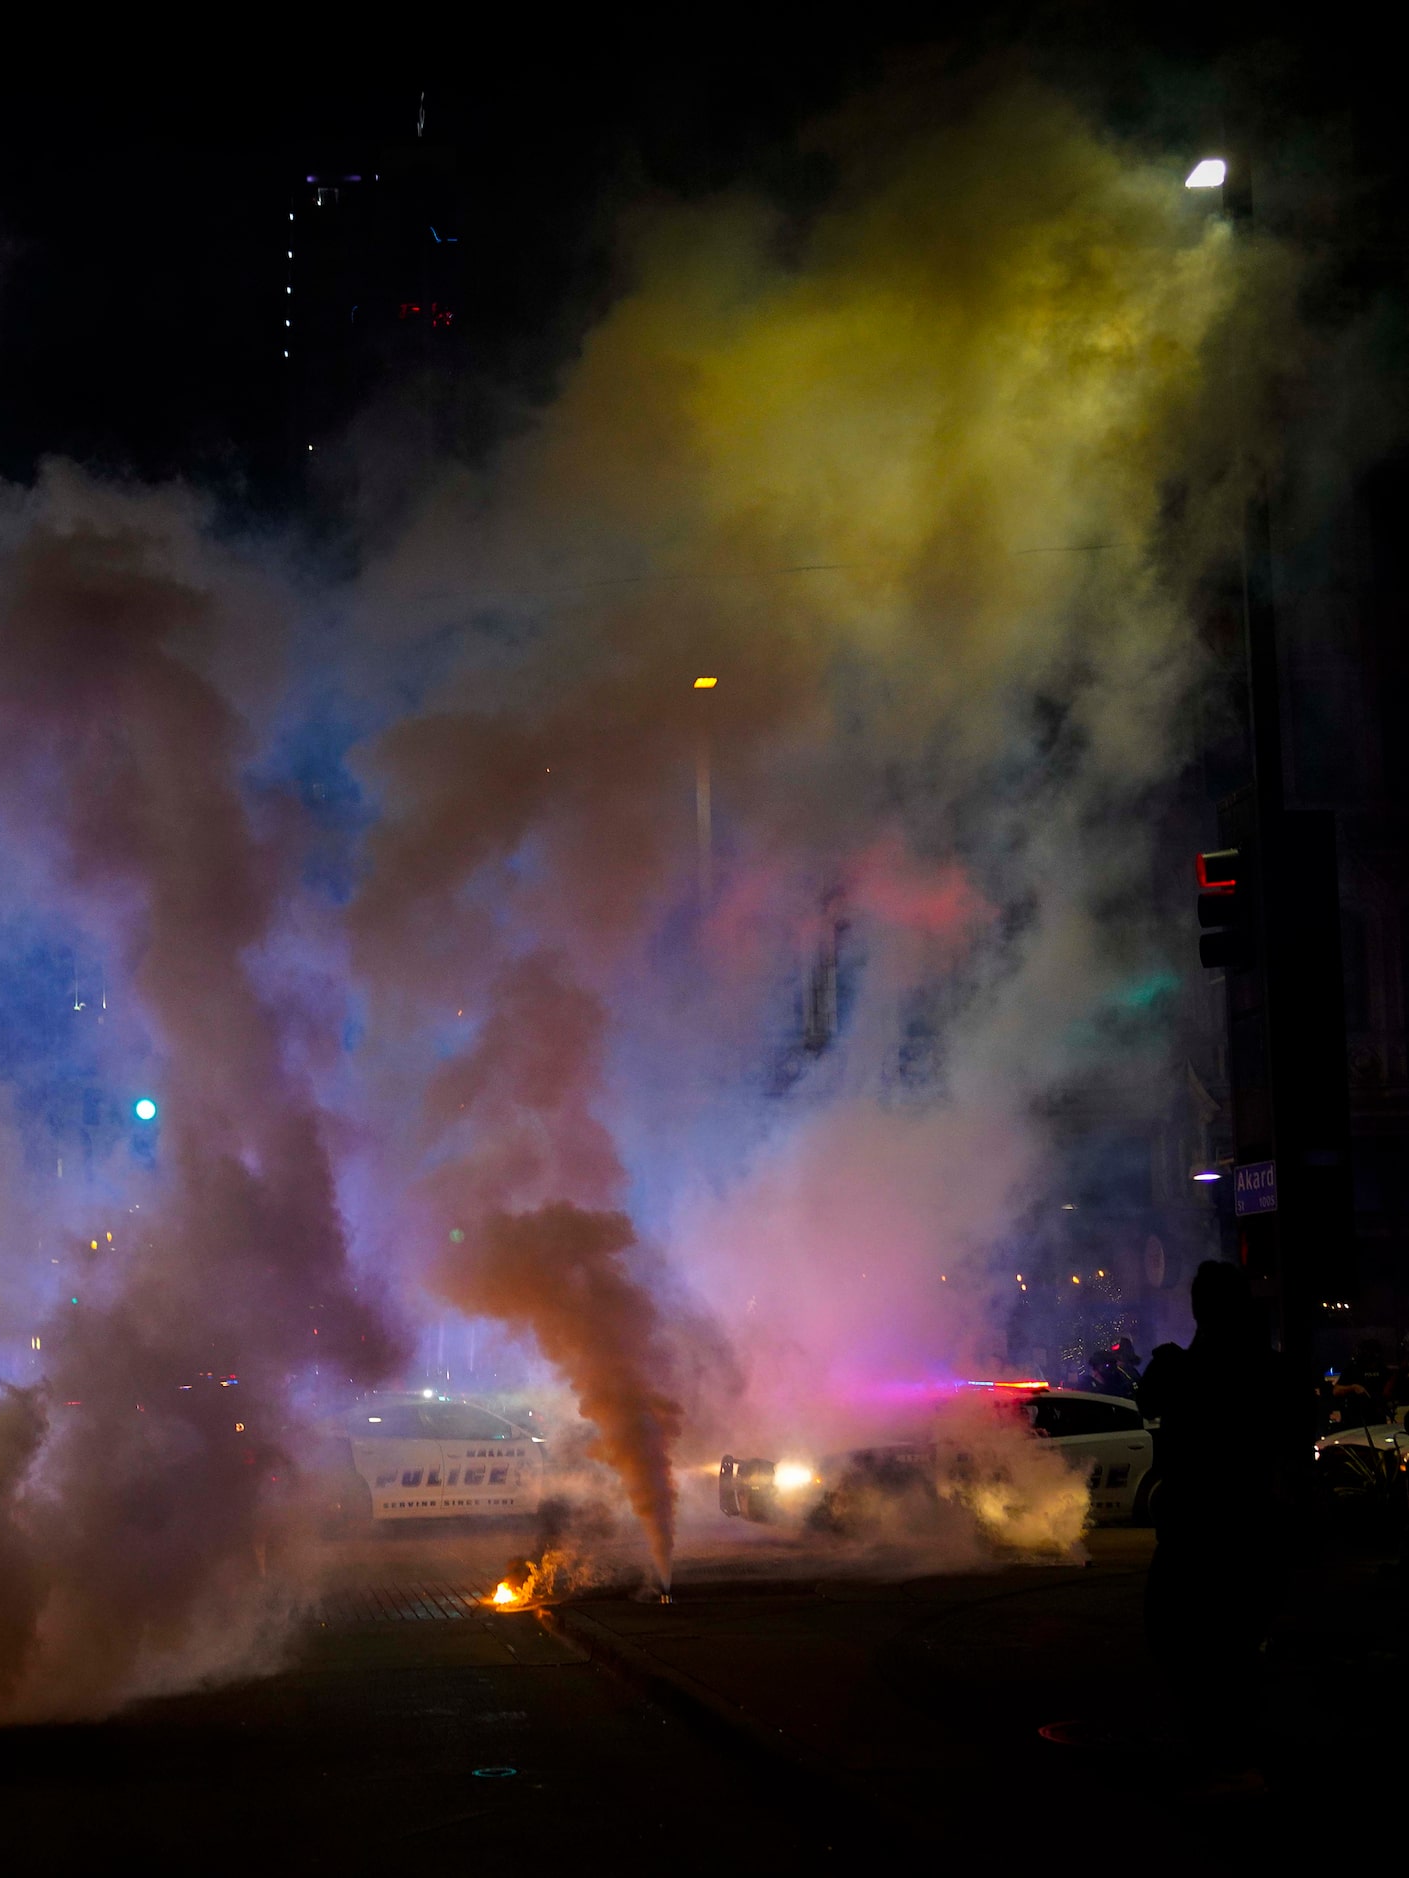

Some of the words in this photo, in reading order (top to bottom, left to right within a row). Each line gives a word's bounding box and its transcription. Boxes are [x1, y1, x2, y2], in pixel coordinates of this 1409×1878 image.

[1237, 1164, 1274, 1192] Akard
[1237, 1199, 1245, 1212] St
[376, 1463, 510, 1488] POLICE
[383, 1498, 437, 1508] SERVING
[443, 1498, 480, 1507] SINCE
